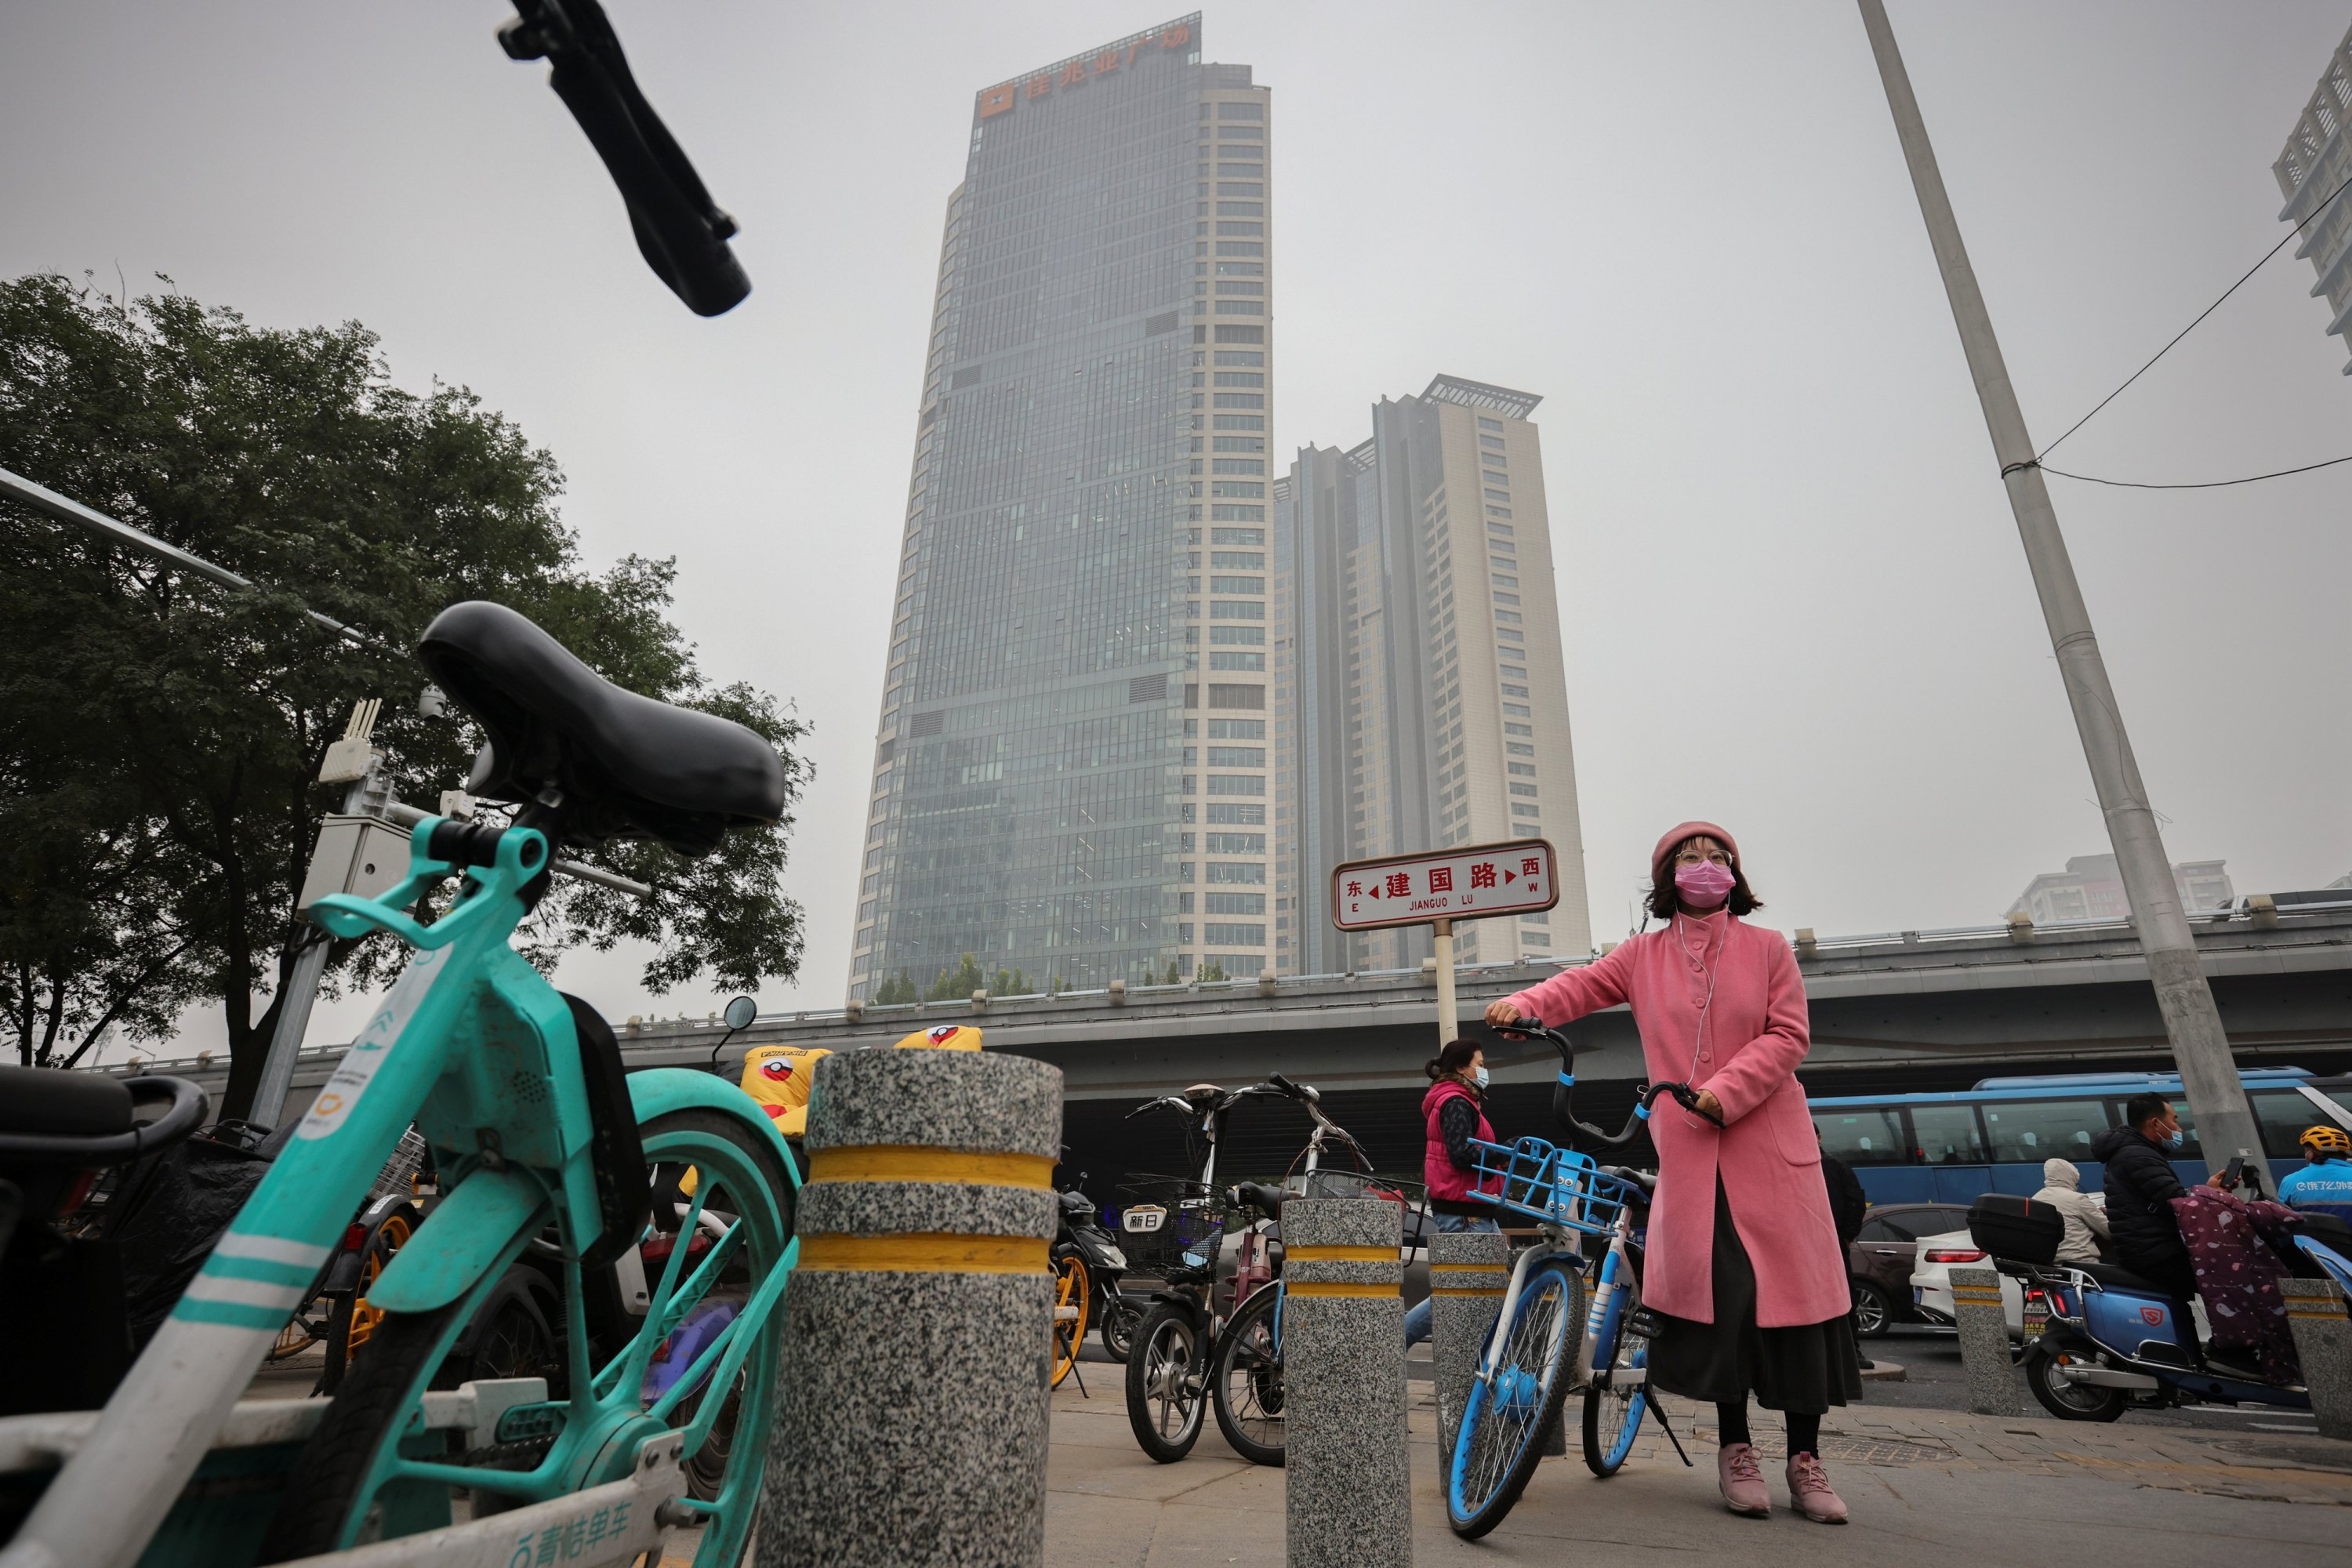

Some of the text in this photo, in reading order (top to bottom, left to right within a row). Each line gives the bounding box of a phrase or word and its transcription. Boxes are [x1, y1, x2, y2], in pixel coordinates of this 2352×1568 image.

[1025, 22, 1190, 101] 佳兆业广场
[1521, 857, 1540, 877] 西
[1385, 862, 1497, 899] 建国路
[1528, 883, 1538, 892] W
[1347, 881, 1363, 898] 东
[1352, 903, 1359, 913] E
[1409, 894, 1473, 911] JIANGUO LU
[1130, 1215, 1157, 1228] 新日
